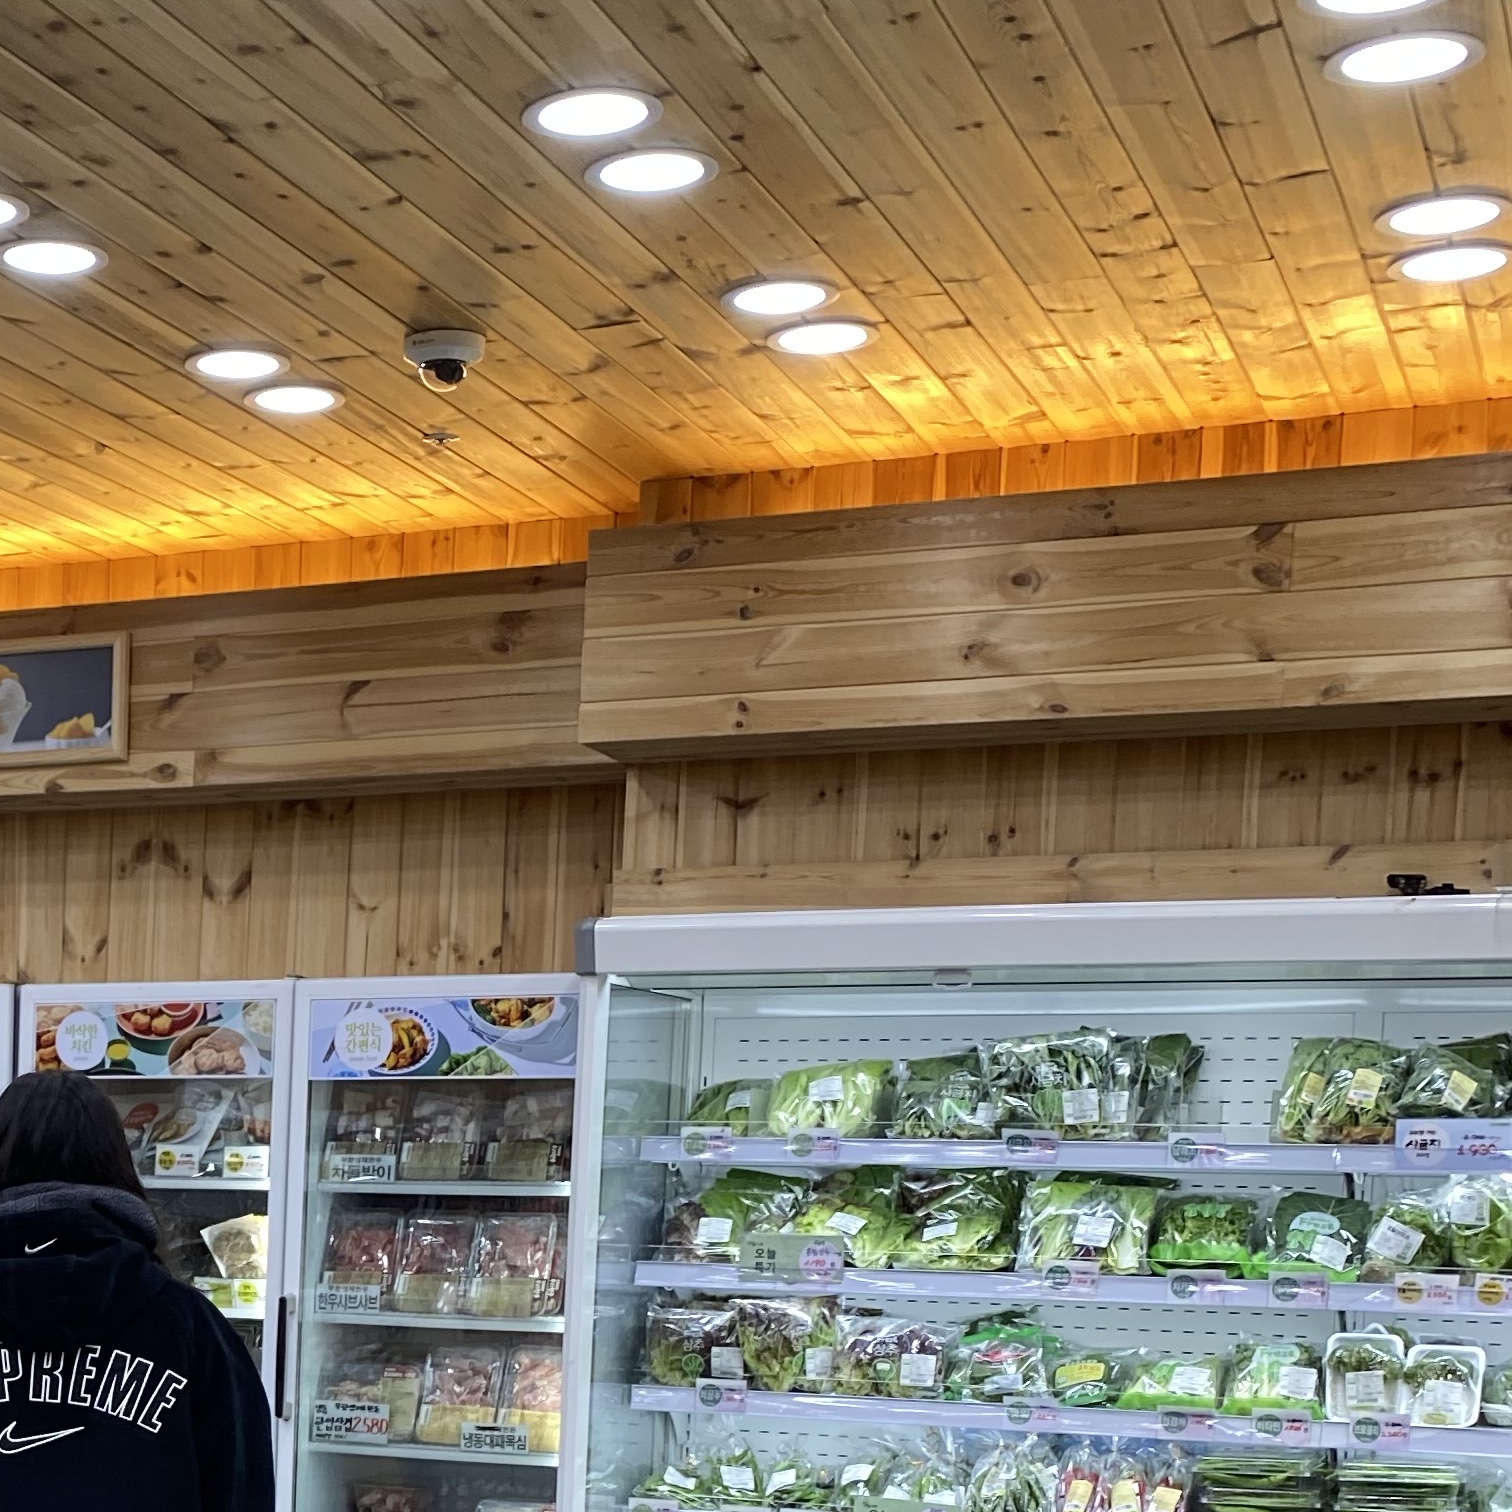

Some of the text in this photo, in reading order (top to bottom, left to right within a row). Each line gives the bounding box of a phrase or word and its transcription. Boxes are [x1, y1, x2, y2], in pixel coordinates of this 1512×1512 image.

[65, 1023, 98, 1038] 바삭한
[345, 1022, 383, 1037] 맛있는
[71, 1037, 93, 1054] 치킨
[345, 1037, 382, 1054] 간편식
[331, 1164, 392, 1181] 차돌박이
[317, 1293, 379, 1312] 한우샤브샤브
[682, 1338, 705, 1353] 상추
[462, 1432, 528, 1451] 냉동대패목심
